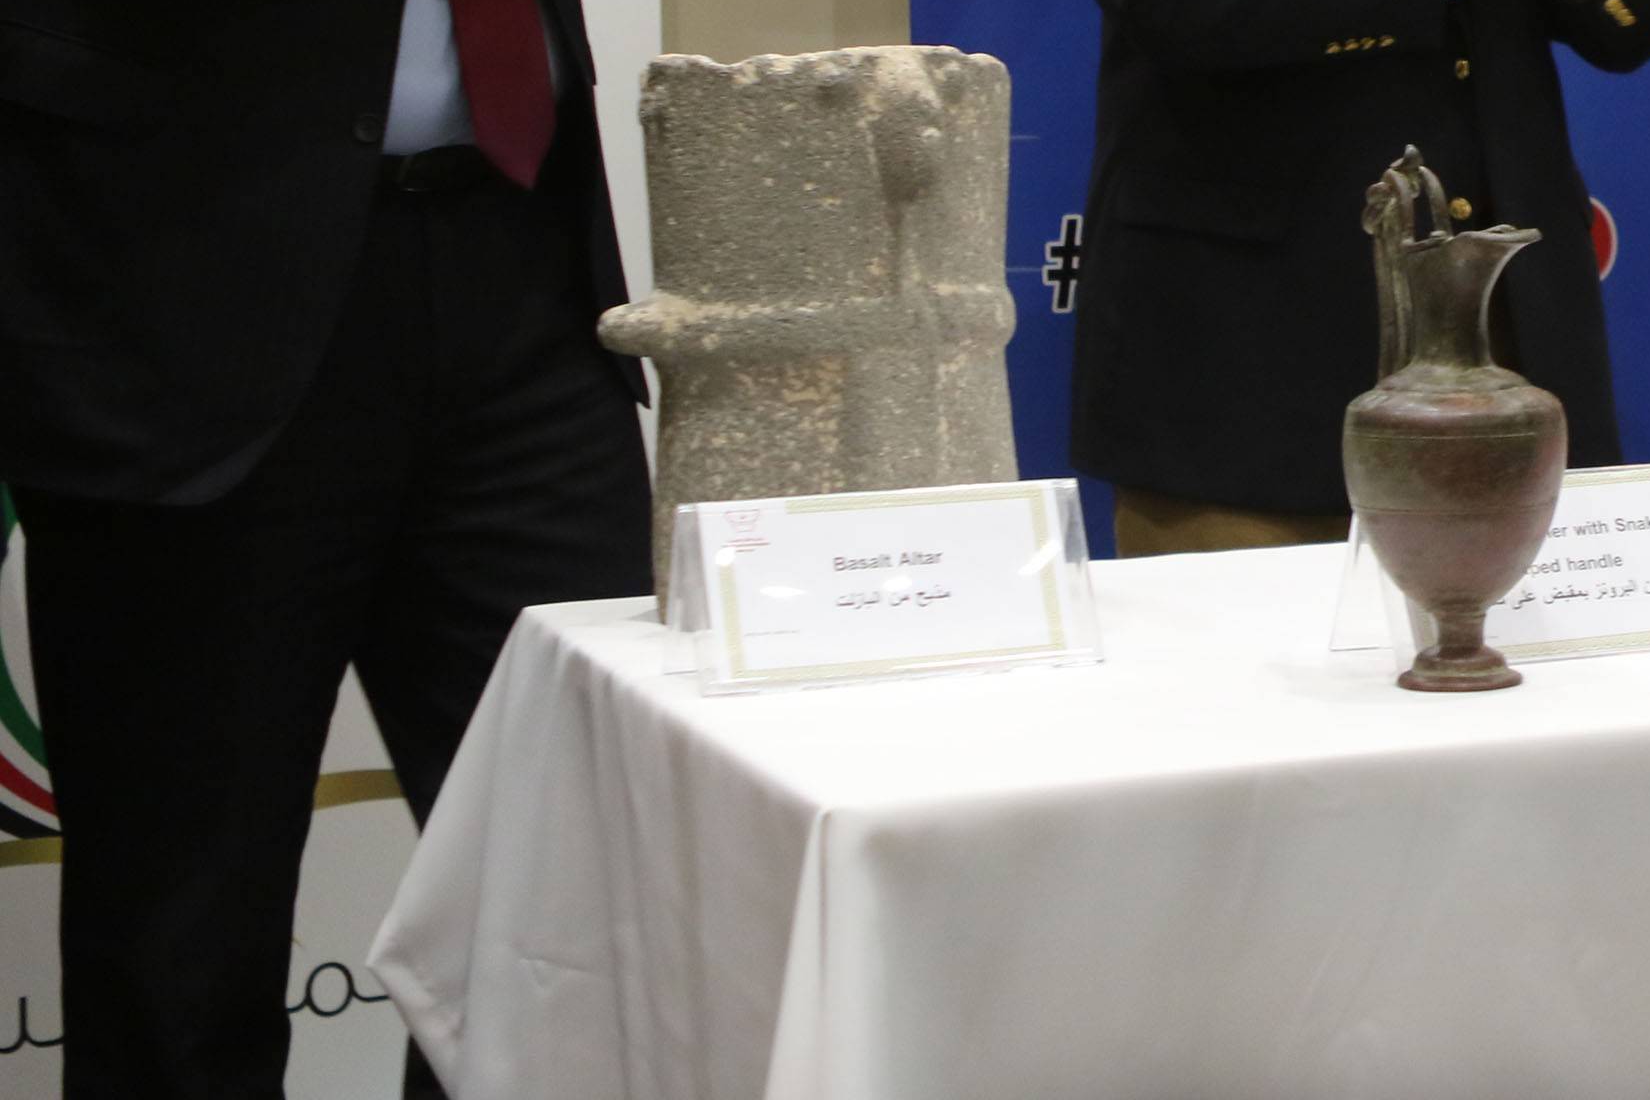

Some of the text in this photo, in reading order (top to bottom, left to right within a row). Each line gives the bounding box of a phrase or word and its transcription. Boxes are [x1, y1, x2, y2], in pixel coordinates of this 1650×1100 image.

[1575, 519, 1609, 537] with
[833, 549, 943, 572] Basalt Altar
[1566, 552, 1625, 573] handle
